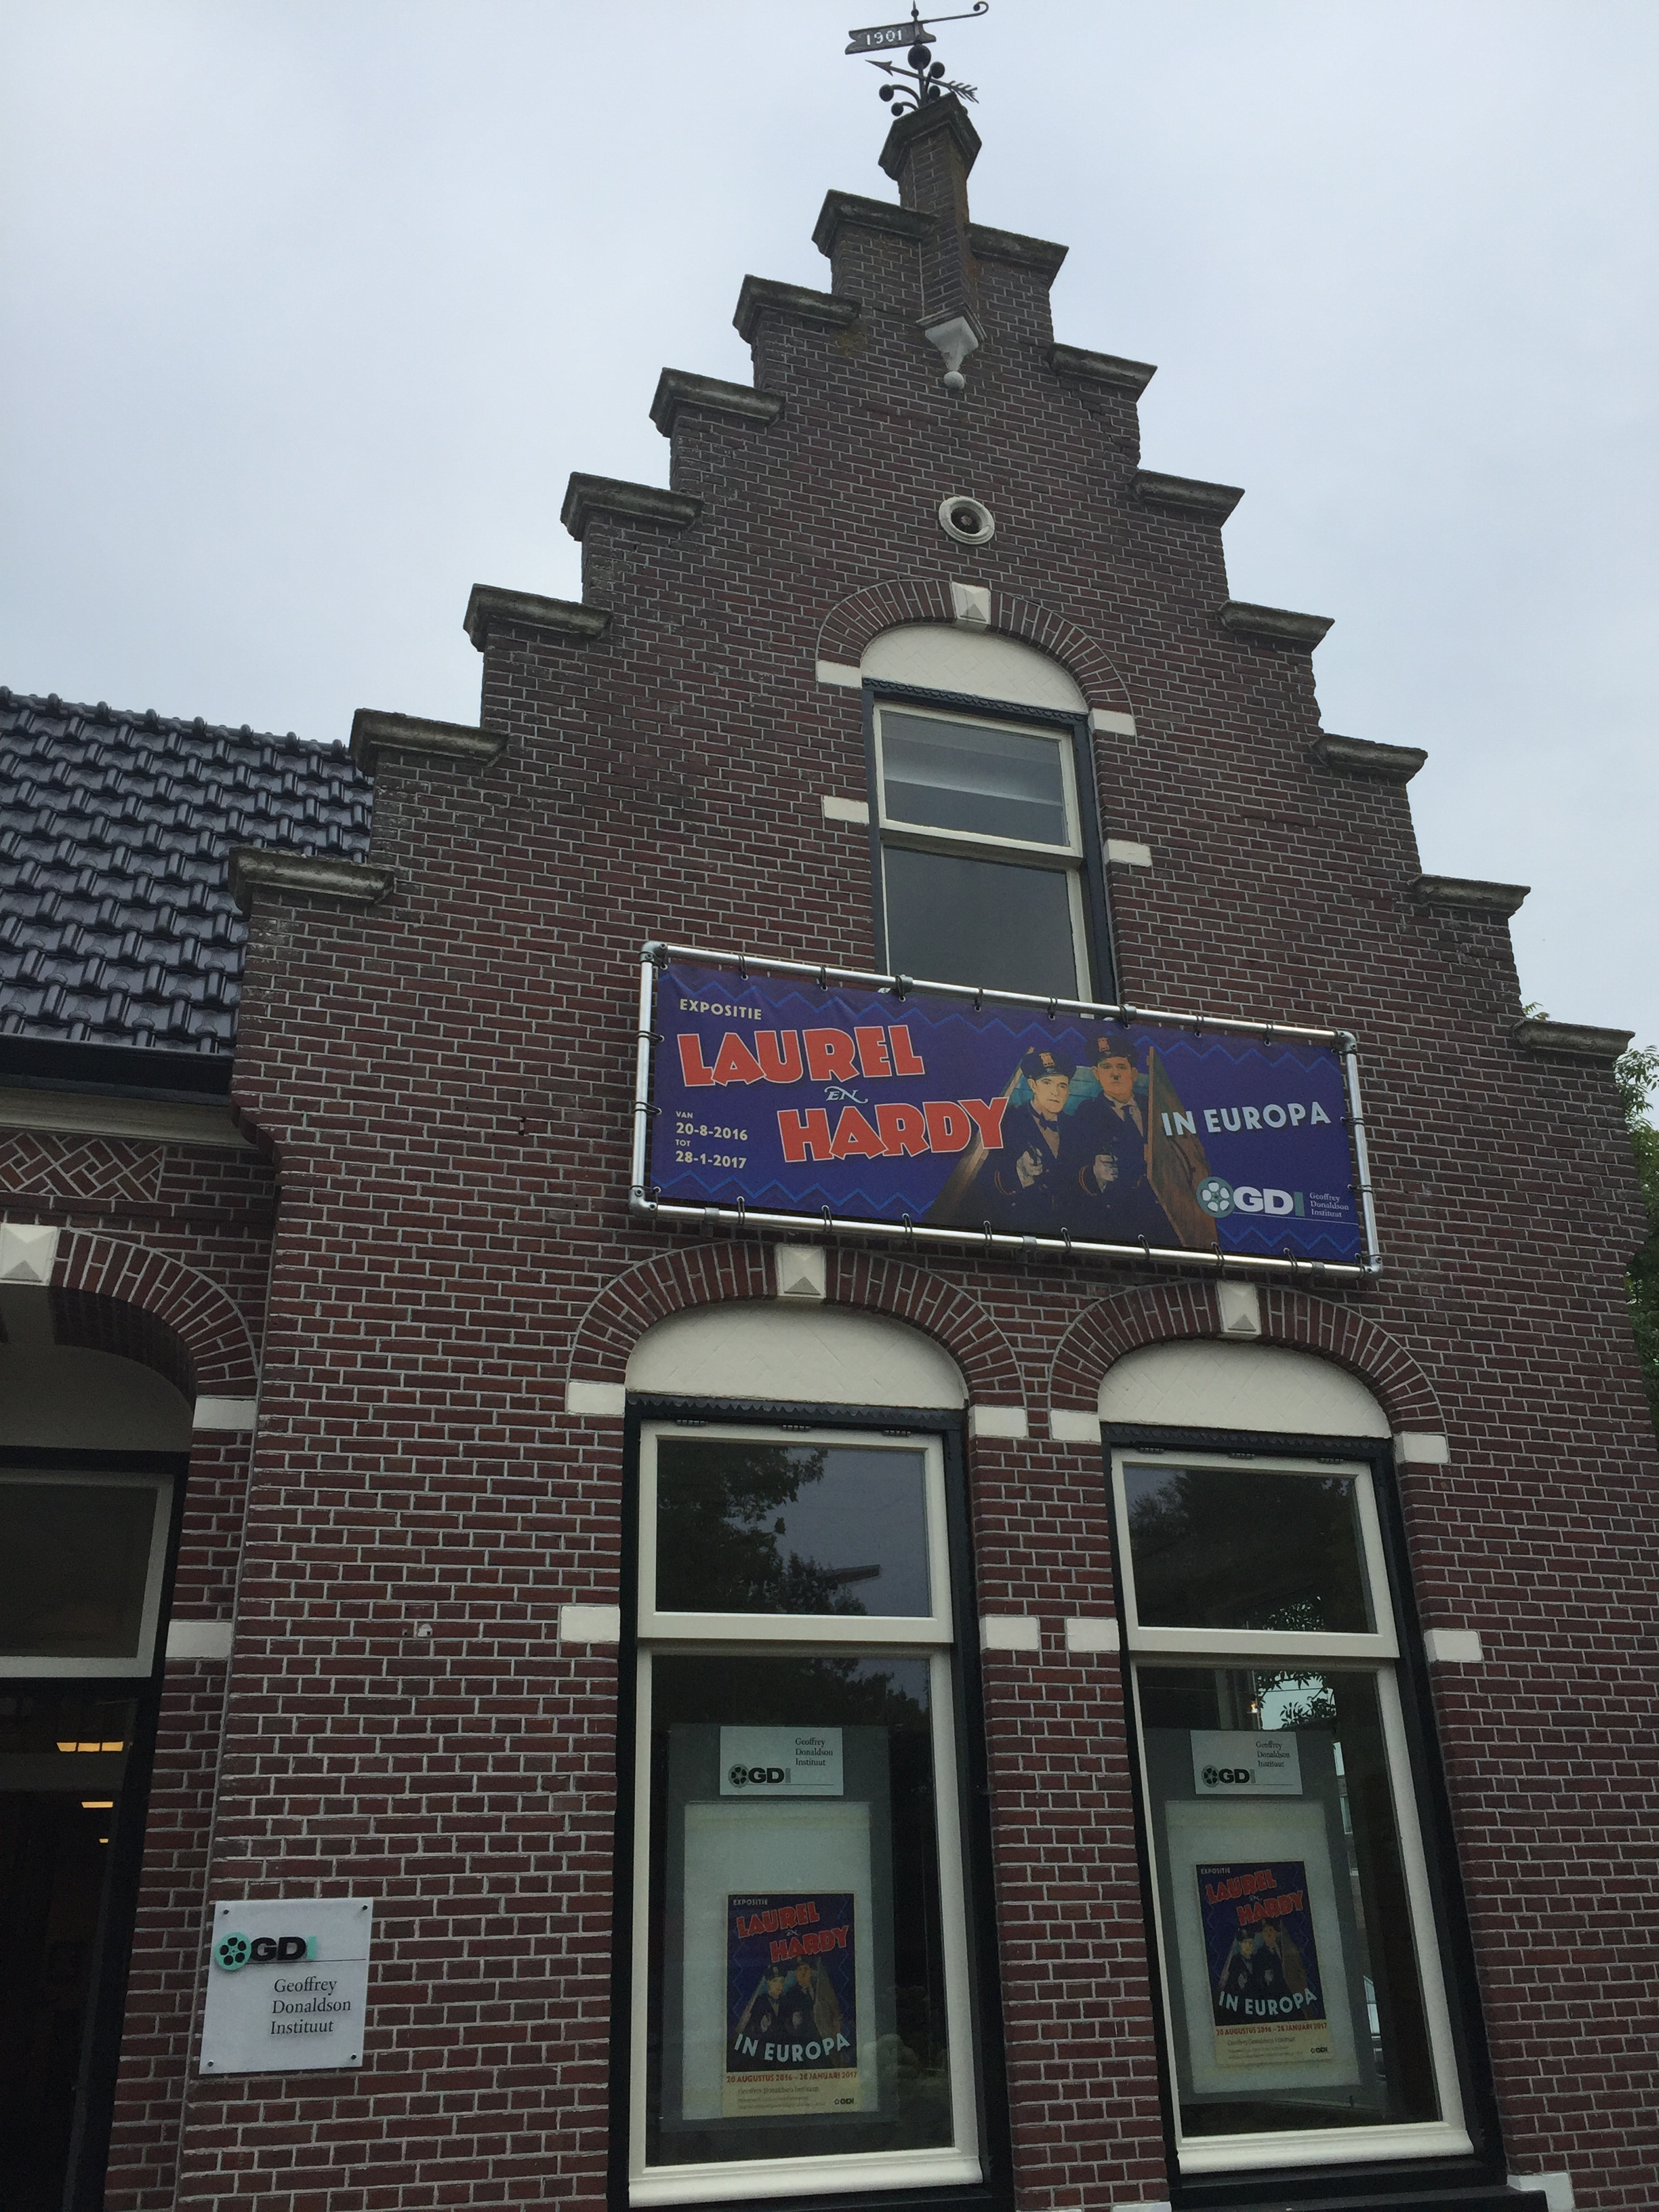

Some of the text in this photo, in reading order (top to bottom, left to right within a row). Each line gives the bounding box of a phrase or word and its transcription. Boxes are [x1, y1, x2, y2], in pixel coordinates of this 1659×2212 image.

[866, 30, 902, 45] 1901
[680, 999, 762, 1020] EXPOSITIE
[678, 1025, 925, 1087] LAUREL
[825, 1086, 868, 1103] EN
[676, 1111, 693, 1120] VAN
[1161, 1101, 1332, 1136] IN EUROPA
[676, 1122, 748, 1141] 20-8-2016
[777, 1097, 1009, 1163] HARDY
[675, 1139, 691, 1147] TOT
[675, 1151, 747, 1170] 28-1-2017
[1233, 1186, 1305, 1217] GDI
[1309, 1192, 1340, 1202] Geoffrey
[1310, 1200, 1349, 1210] Donaldson
[1311, 1208, 1343, 1218] Instituut
[795, 1738, 825, 1748] Geoffrey
[1256, 1740, 1282, 1750] Geoffrey
[795, 1748, 833, 1756] Donaldson
[1257, 1750, 1290, 1759] Donaldson
[748, 1767, 791, 1784] GDI
[1218, 1769, 1256, 1784] GDI
[1205, 1869, 1277, 1904] LAUREL
[1236, 1889, 1304, 1926] HARDY
[737, 1902, 820, 1938] LAUREL
[251, 1936, 318, 1961] GDI
[770, 1925, 849, 1963] HARDY
[274, 1976, 337, 1995] Geoffrey
[272, 1997, 352, 2013] Donaldson
[1218, 1988, 1318, 2016] IN EUROPA
[270, 2019, 334, 2034] Instituut
[1225, 2027, 1256, 2035] AUGUSTUS
[734, 2032, 851, 2062] IN EUROPA
[737, 2074, 774, 2083] AUGUSTUS
[776, 2073, 793, 2081] 2016
[809, 2072, 840, 2080] JANUARI
